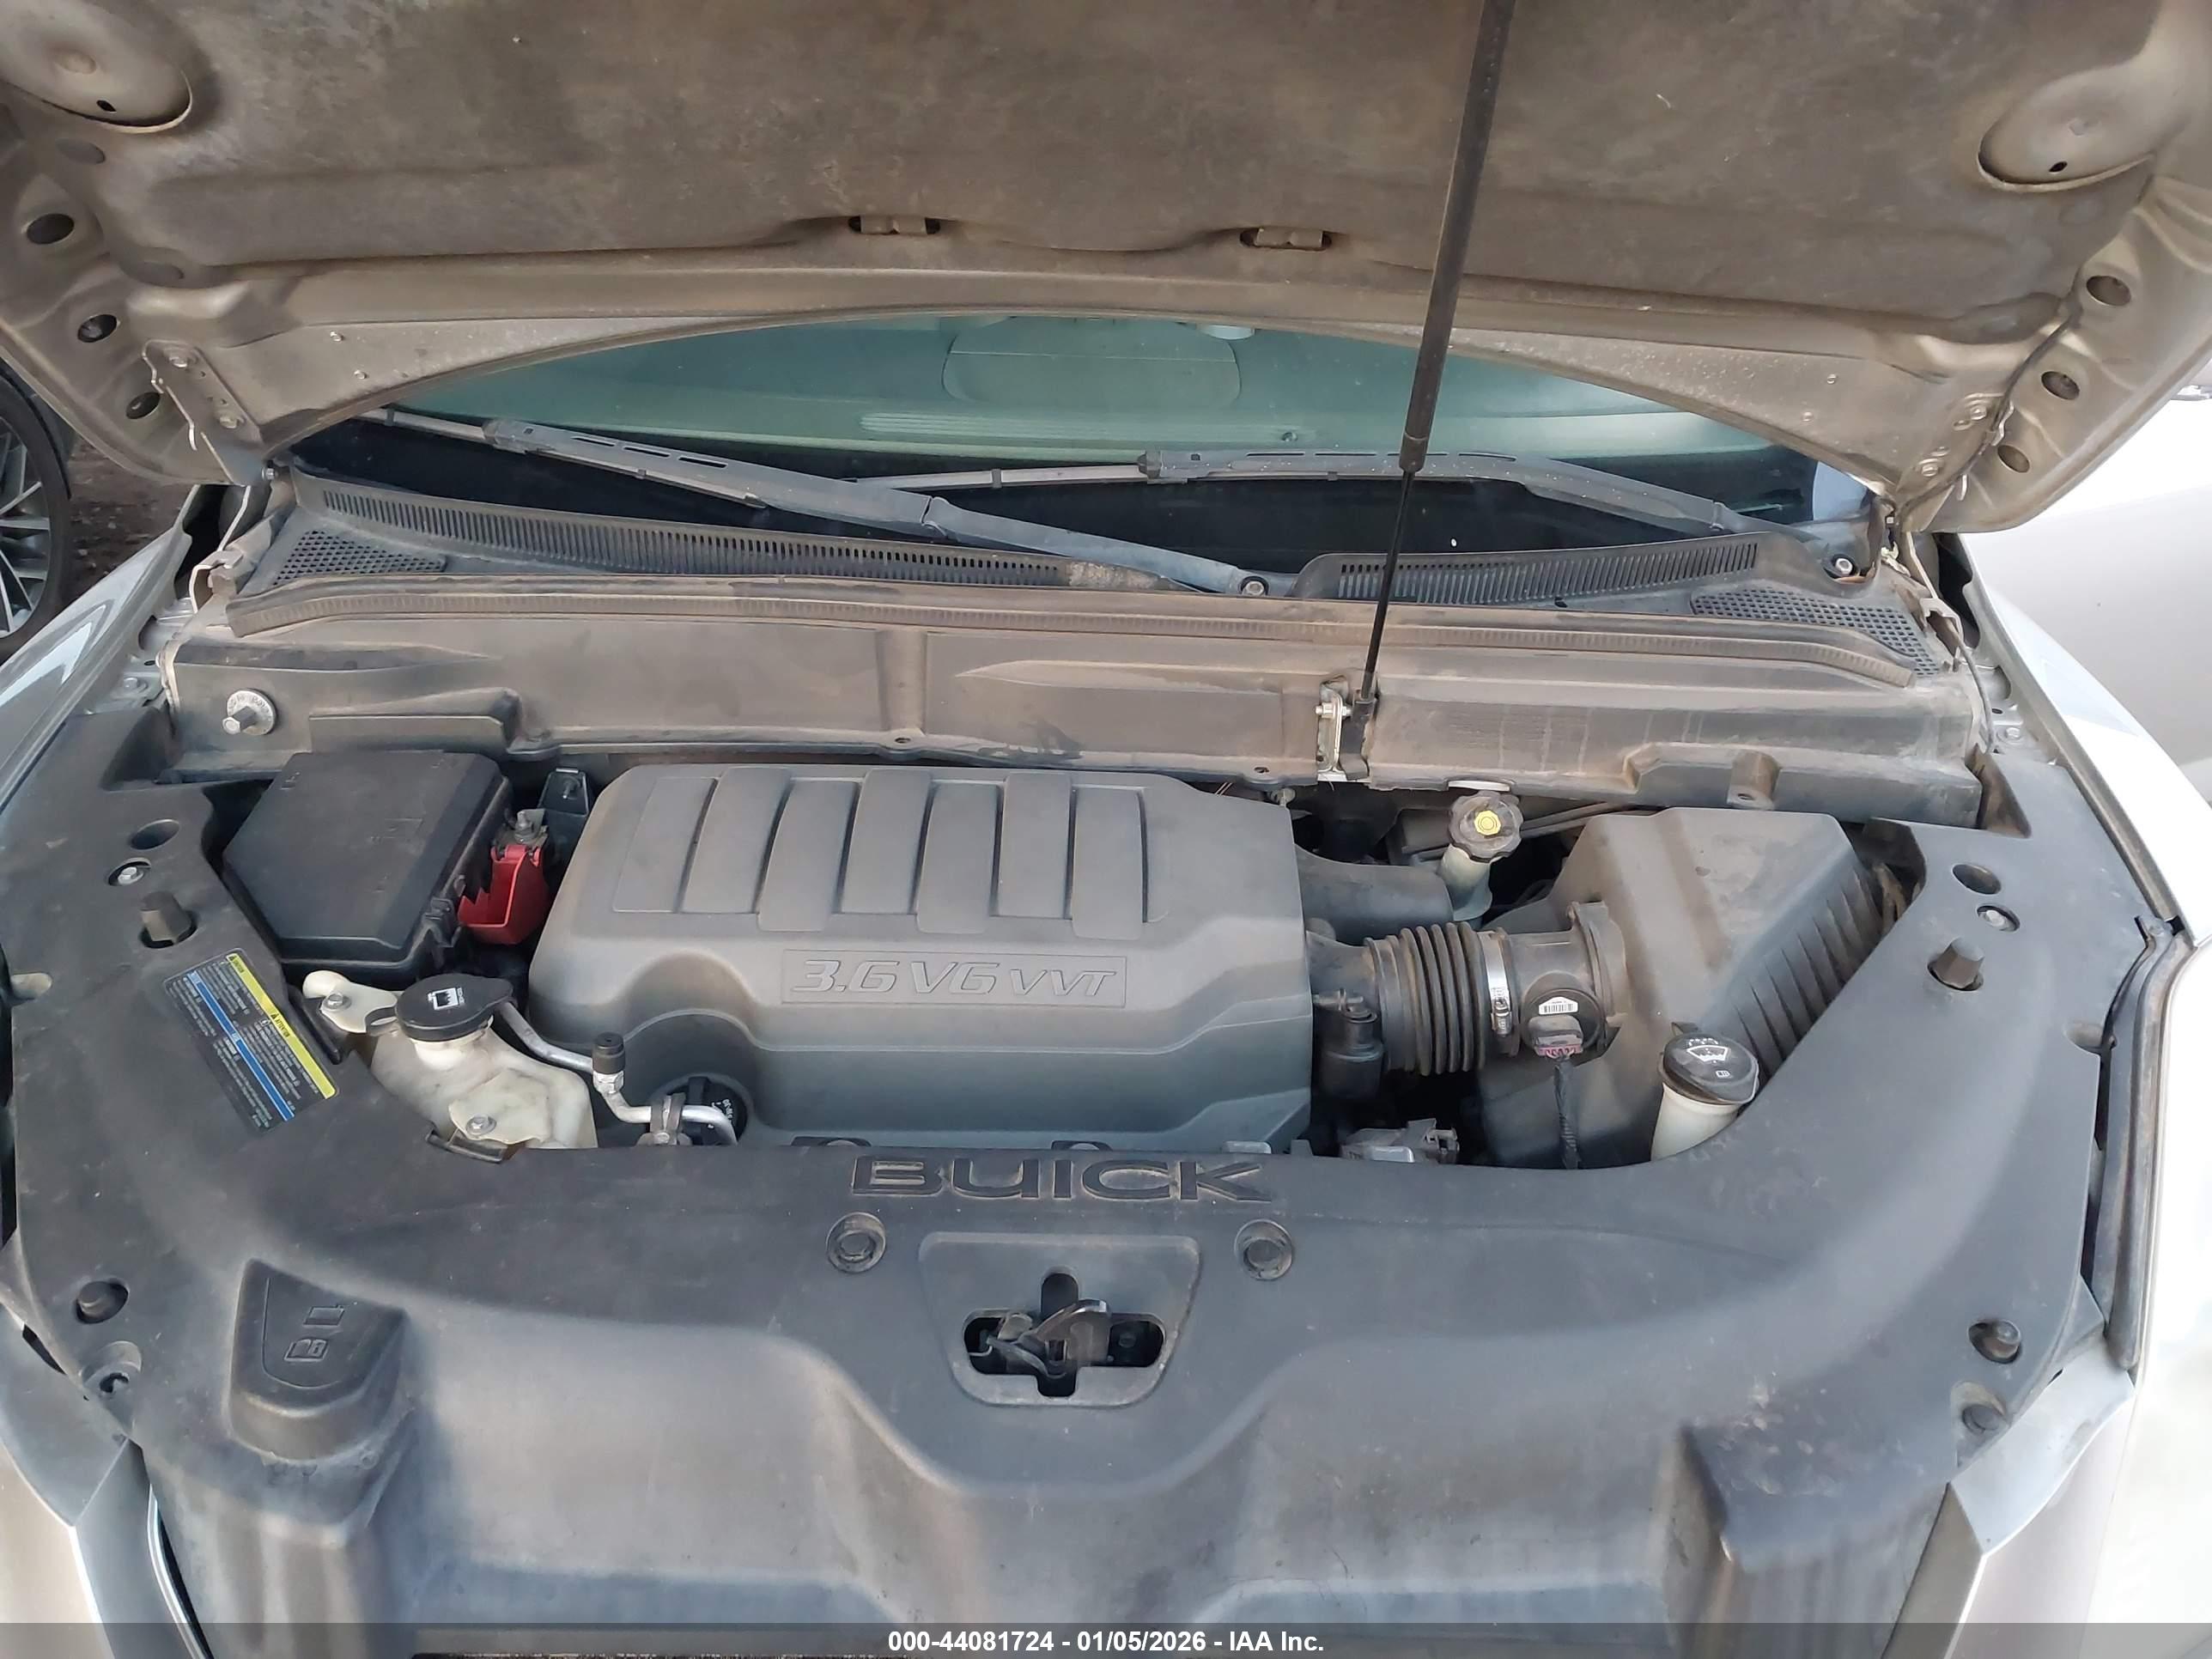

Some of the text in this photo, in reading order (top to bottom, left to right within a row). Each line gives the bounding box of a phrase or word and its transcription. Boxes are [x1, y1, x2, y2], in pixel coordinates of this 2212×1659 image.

[790, 958, 1116, 997] 3.6 V6 VVT
[851, 1156, 1271, 1202] BUICK
